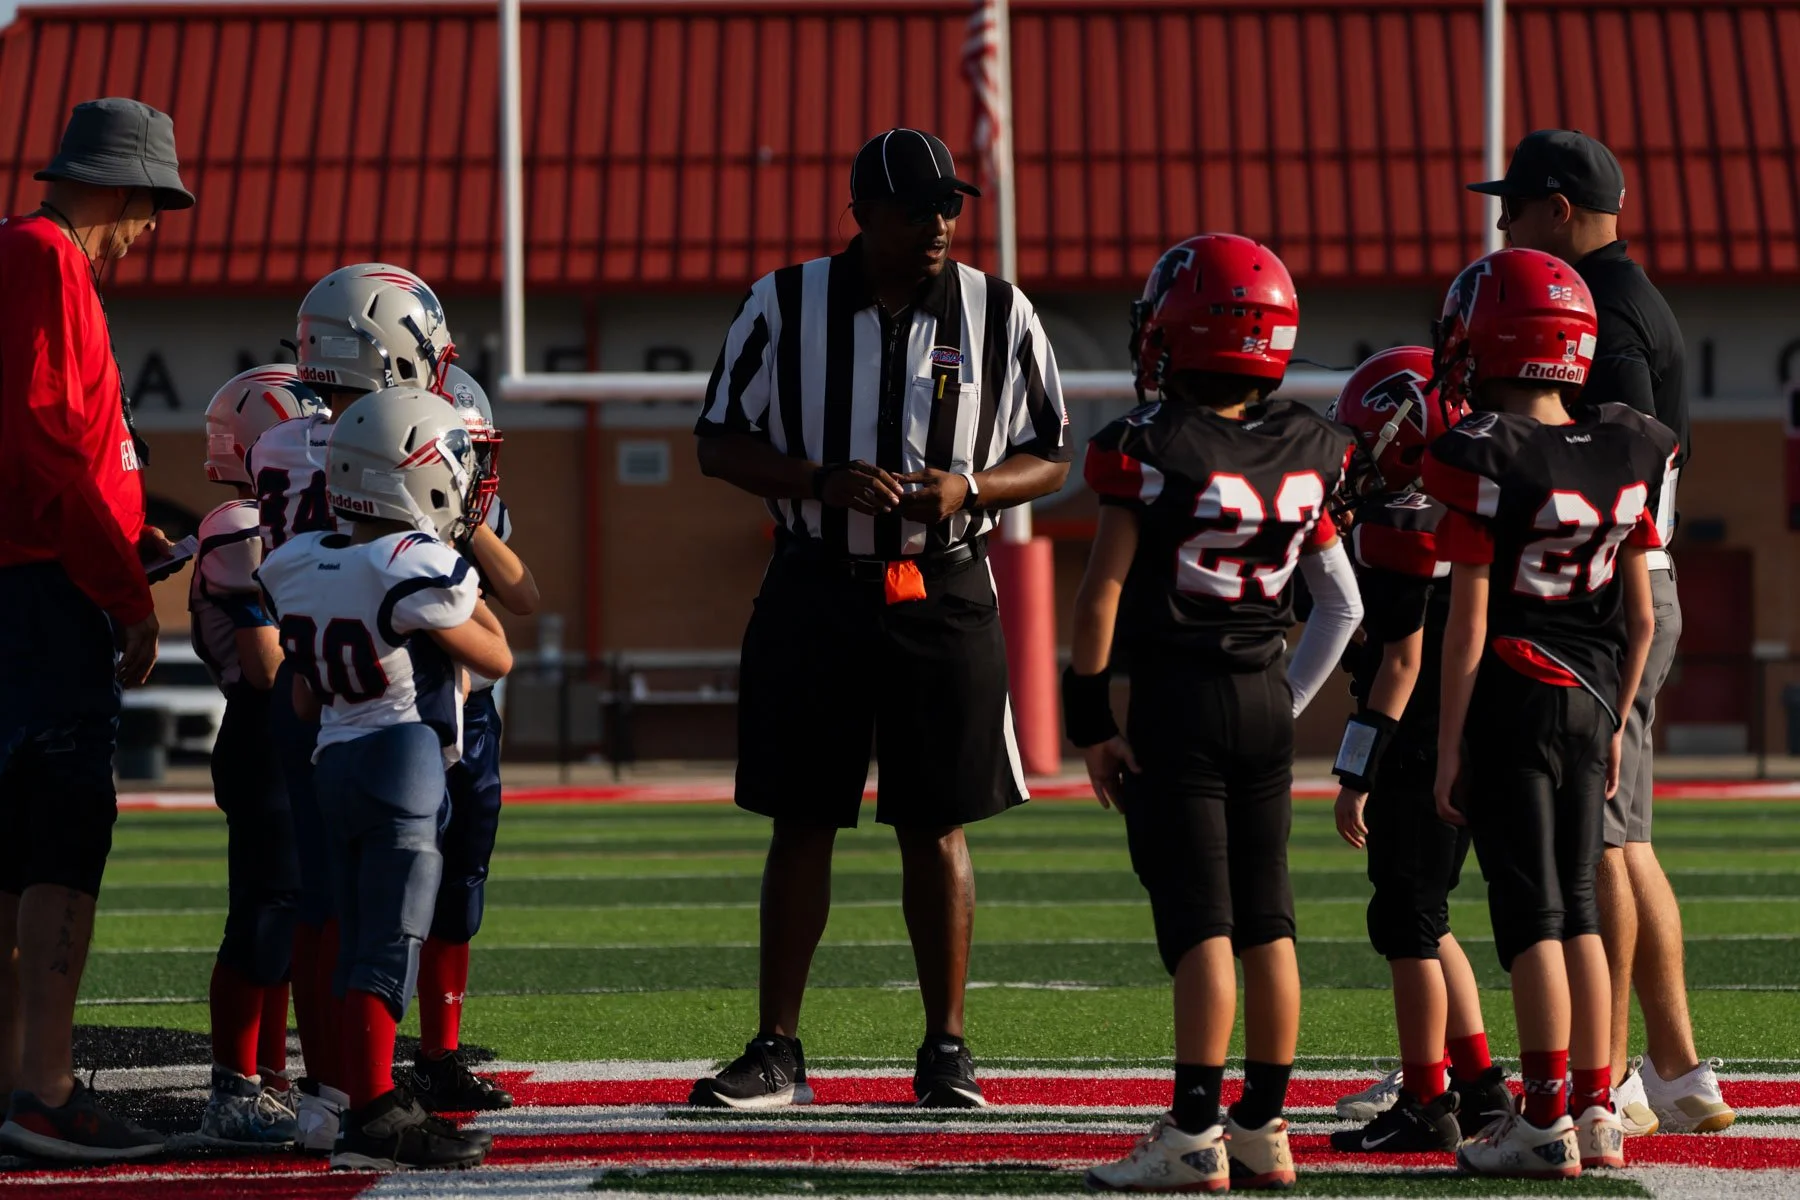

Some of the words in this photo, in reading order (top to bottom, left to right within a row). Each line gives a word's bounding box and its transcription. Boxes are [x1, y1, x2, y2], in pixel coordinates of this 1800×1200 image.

[299, 366, 336, 383] iddell
[1525, 363, 1583, 381] Riddell
[1175, 469, 1326, 602] 23
